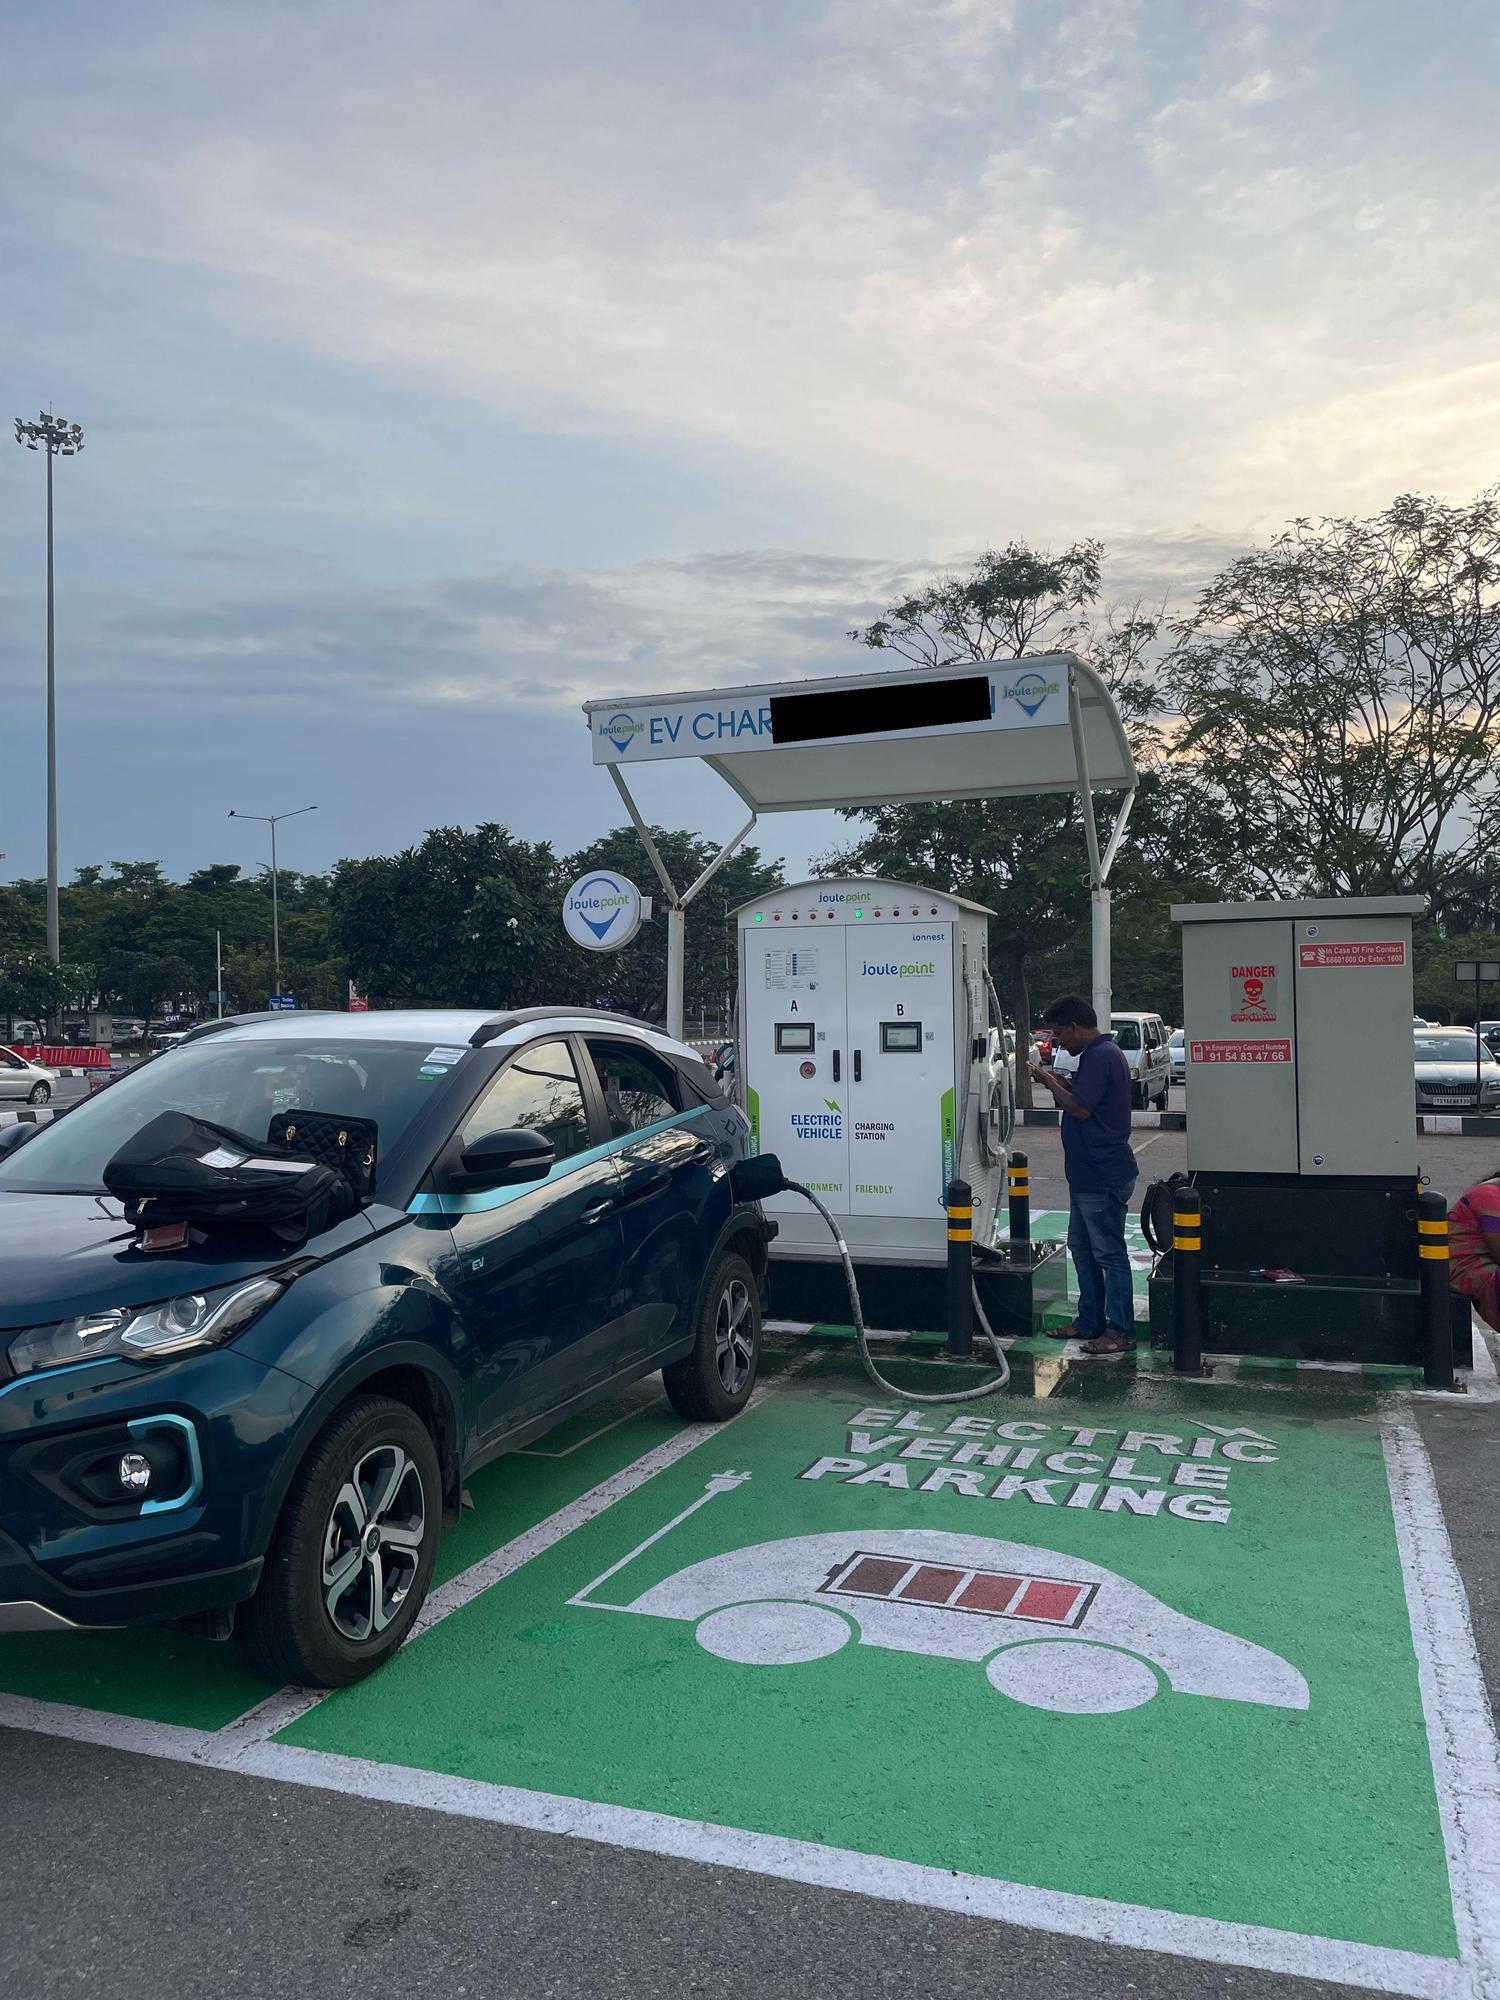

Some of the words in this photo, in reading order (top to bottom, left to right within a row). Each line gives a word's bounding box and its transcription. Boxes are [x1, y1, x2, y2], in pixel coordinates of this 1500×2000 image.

[650, 715, 683, 744] EV
[569, 894, 630, 910] joulepoint
[818, 891, 872, 904] joulepoint
[1333, 946, 1350, 954] Case
[1352, 946, 1360, 954] Of
[1361, 946, 1374, 954] Fire
[1375, 945, 1402, 953] Contact
[1358, 955, 1366, 963] Or
[1387, 954, 1402, 962] 1600
[862, 961, 935, 978] joulepoint
[1231, 965, 1275, 978] DANGER
[790, 1000, 798, 1012] A
[896, 1003, 904, 1016] B
[1212, 1044, 1241, 1053] Emergency
[1243, 1043, 1264, 1051] Contact
[1265, 1043, 1287, 1051] Number
[1210, 1052, 1220, 1061] 91
[1225, 1052, 1237, 1061] 54
[1240, 1052, 1252, 1061] 83
[1255, 1052, 1268, 1061] 47
[1271, 1051, 1284, 1060] 66
[791, 1114, 842, 1126] ELECTRIC
[855, 1122, 894, 1131] CHARGING
[796, 1127, 842, 1139] VEHICLE
[855, 1132, 885, 1140] STATION
[855, 1184, 893, 1194] FRIENDLY
[471, 1256, 484, 1271] EV
[846, 1407, 1280, 1463] ELECTRIC
[846, 1431, 1232, 1490] VEHICLE
[798, 1456, 1232, 1524] PARKING
